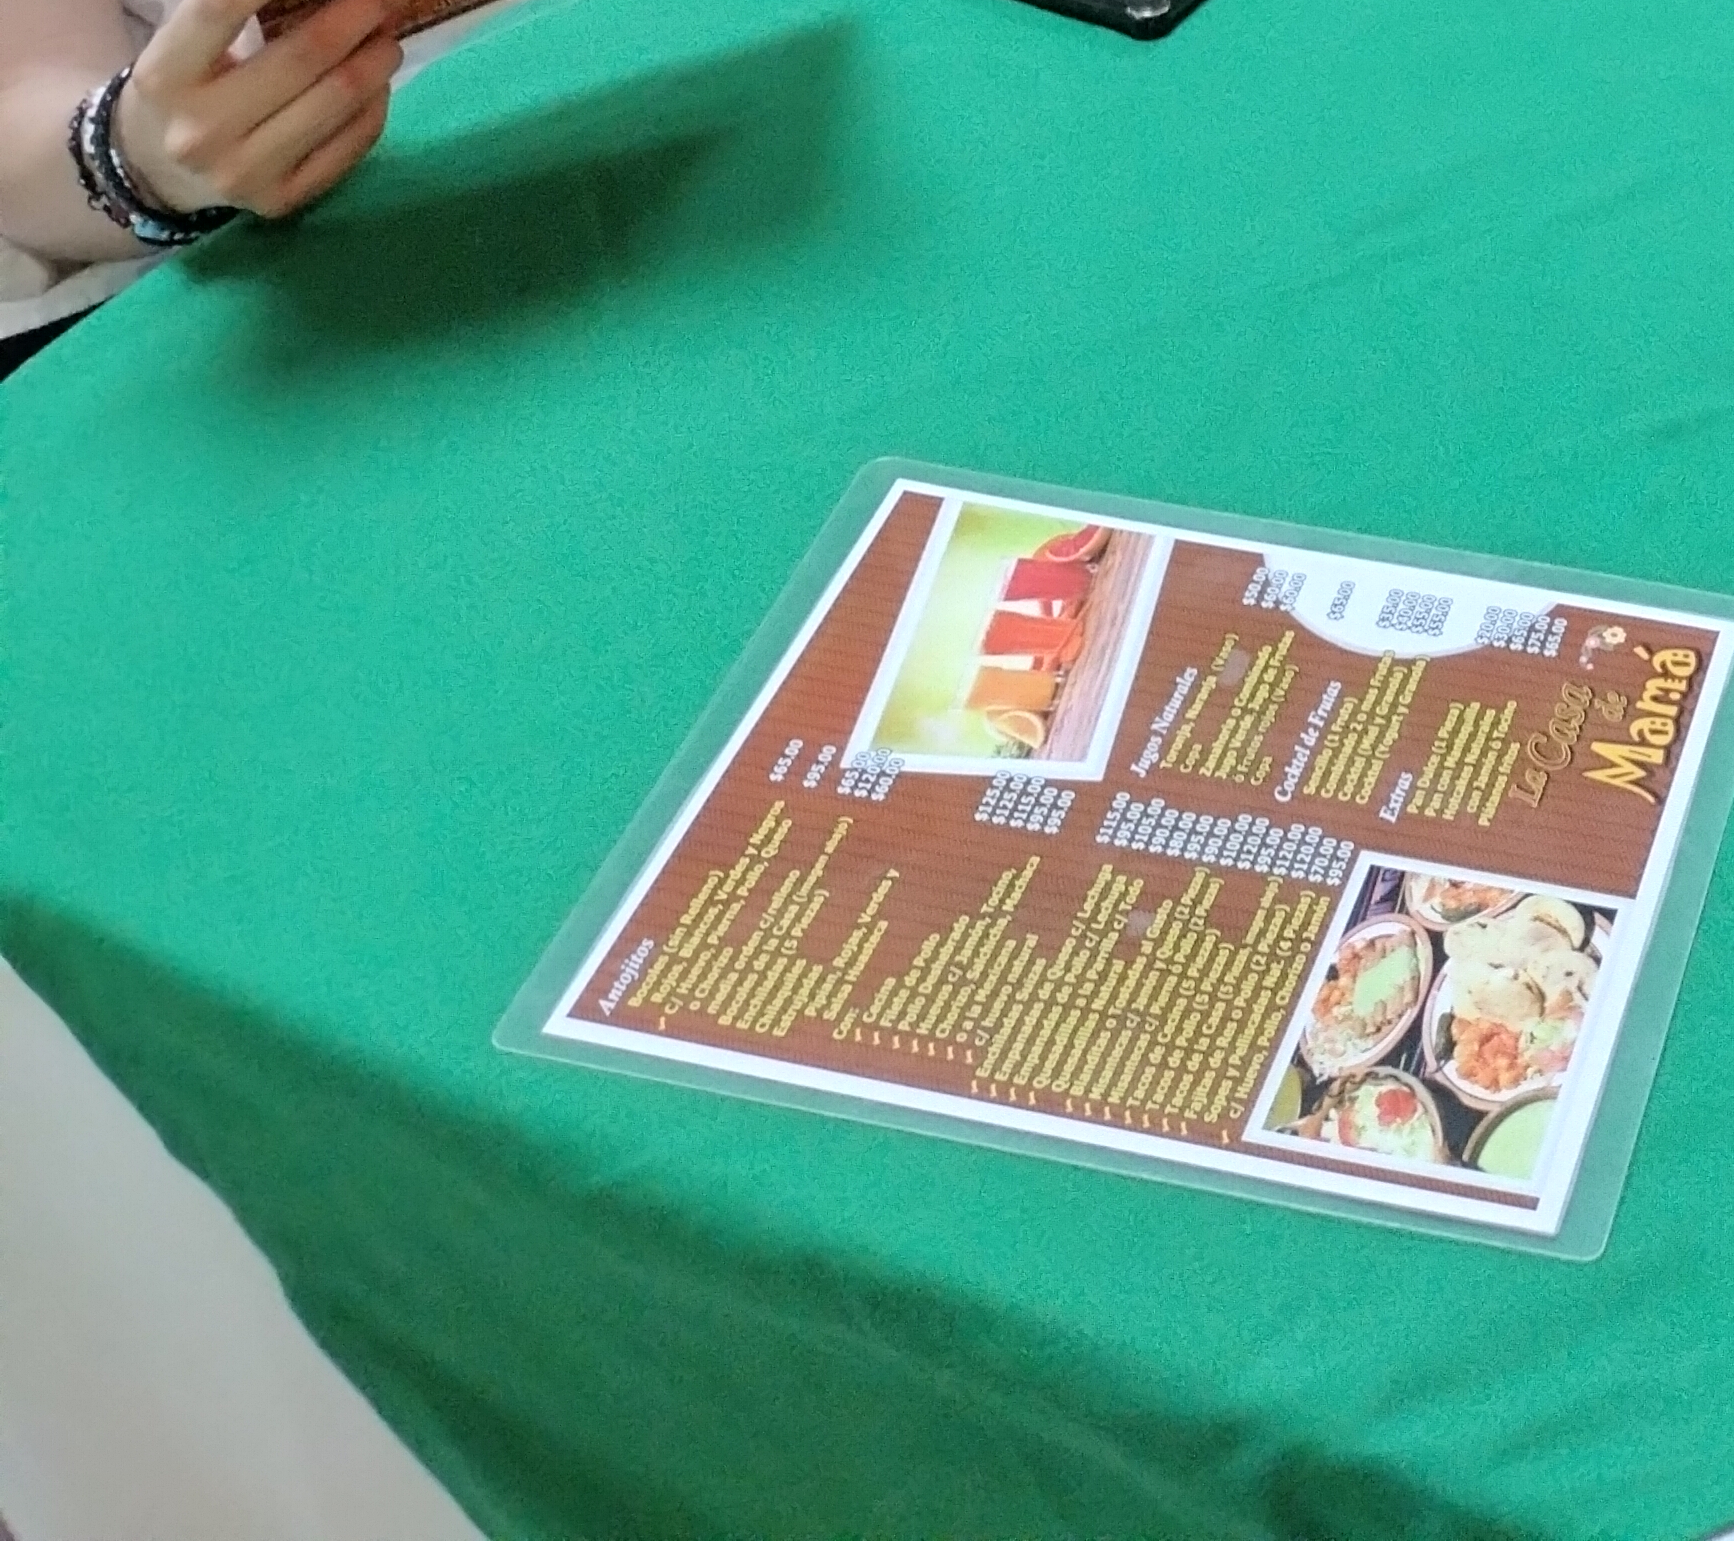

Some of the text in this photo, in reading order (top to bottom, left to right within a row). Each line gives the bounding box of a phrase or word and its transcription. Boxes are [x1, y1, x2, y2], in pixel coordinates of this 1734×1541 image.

[1128, 666, 1199, 778] Jugos Naturales
[1184, 674, 1219, 720] Naranja
[1210, 632, 1240, 671] (Vaso)
[1198, 717, 1237, 777] Zanahoria
[1232, 644, 1273, 707] Combinado
[1213, 748, 1239, 779] Jugo
[1246, 682, 1272, 711] Jugo
[1268, 629, 1296, 666] Frutas
[1374, 713, 1405, 759] (Yogurt
[1397, 653, 1433, 705] Granola)
[1491, 699, 1518, 738] Tocino
[1519, 678, 1597, 774] Casa
[1578, 642, 1700, 803] Mamá
[1591, 689, 1629, 722] de
[1178, 742, 1204, 773] Copa
[1236, 702, 1280, 772] Frutos rojos
[1272, 680, 1342, 802] Cocktel Frutas
[1302, 747, 1333, 795] Sencillo
[1330, 696, 1359, 732] Fruta)
[1319, 731, 1359, 798] Combinado
[1360, 687, 1379, 711] mas
[1337, 755, 1367, 801] Cocktel
[1356, 724, 1381, 755] (Miel
[1374, 665, 1408, 716] Granola)
[1405, 788, 1426, 813] Pan
[1416, 753, 1441, 788] Dulce
[1436, 701, 1465, 739] Pieza)
[1436, 768, 1454, 791] con
[1441, 708, 1496, 820] Hotcakes Naturales
[1443, 700, 1482, 768] Mantequilla
[1477, 741, 1521, 826] Plátanos fritos
[1504, 764, 1551, 808] La
[661, 925, 689, 953] (sin
[678, 869, 725, 925] Relleno)
[765, 737, 808, 783] $65.00
[713, 855, 751, 901] Verdes
[748, 799, 787, 845] Negros
[759, 818, 794, 858] Queso
[799, 743, 840, 789] $95.00
[771, 903, 800, 936] Casa
[850, 746, 894, 799] $120.00
[1001, 855, 1041, 912] Machaca
[1040, 788, 1078, 835] $95.00
[1215, 811, 1255, 868] $100.00
[1377, 771, 1414, 823] Extras
[705, 749, 874, 1014] media orden c/relleno $65.00
[735, 755, 908, 1029] Enchiladas Piezas) $60.00
[861, 768, 1013, 1023] Cecina $125.00
[878, 771, 1030, 1027] Filete Pollo $125.00
[915, 982, 954, 1035] Huevos
[1023, 785, 1061, 832] $95.00
[917, 774, 1048, 994] Deshebrado $115.00
[1090, 796, 1168, 929] Lechuga $105.00
[1090, 810, 1199, 1010] Natural $80.00
[1130, 969, 1161, 1011] Jamón
[1197, 816, 1234, 864] $90.00
[595, 937, 657, 1016] Antojitos
[693, 945, 734, 998] Chorizo
[822, 919, 889, 1020] Salsa Huasteca
[973, 938, 1017, 1002] Mexicana
[974, 790, 1133, 1077] Enchiladas Suizas $115.00
[980, 932, 1039, 1027] huevo natural
[993, 862, 1115, 1081] Empanadas Lechuga
[1031, 806, 1182, 1089] Quesadillas Parrilla Todo $90.00
[1125, 814, 1272, 1107] Tacos Cecina $120.00
[1200, 821, 1308, 1035] Casa $120.00
[1202, 1078, 1235, 1123] Sopes
[1305, 835, 1339, 883] $70.00
[753, 957, 809, 1034] Chilaquiles
[831, 1007, 860, 1040] Con:
[1069, 898, 1174, 1096] Blanditas Tostadas Gusto
[1144, 1068, 1176, 1111] Tacos
[1183, 1020, 1238, 1119] Fajitas Res
